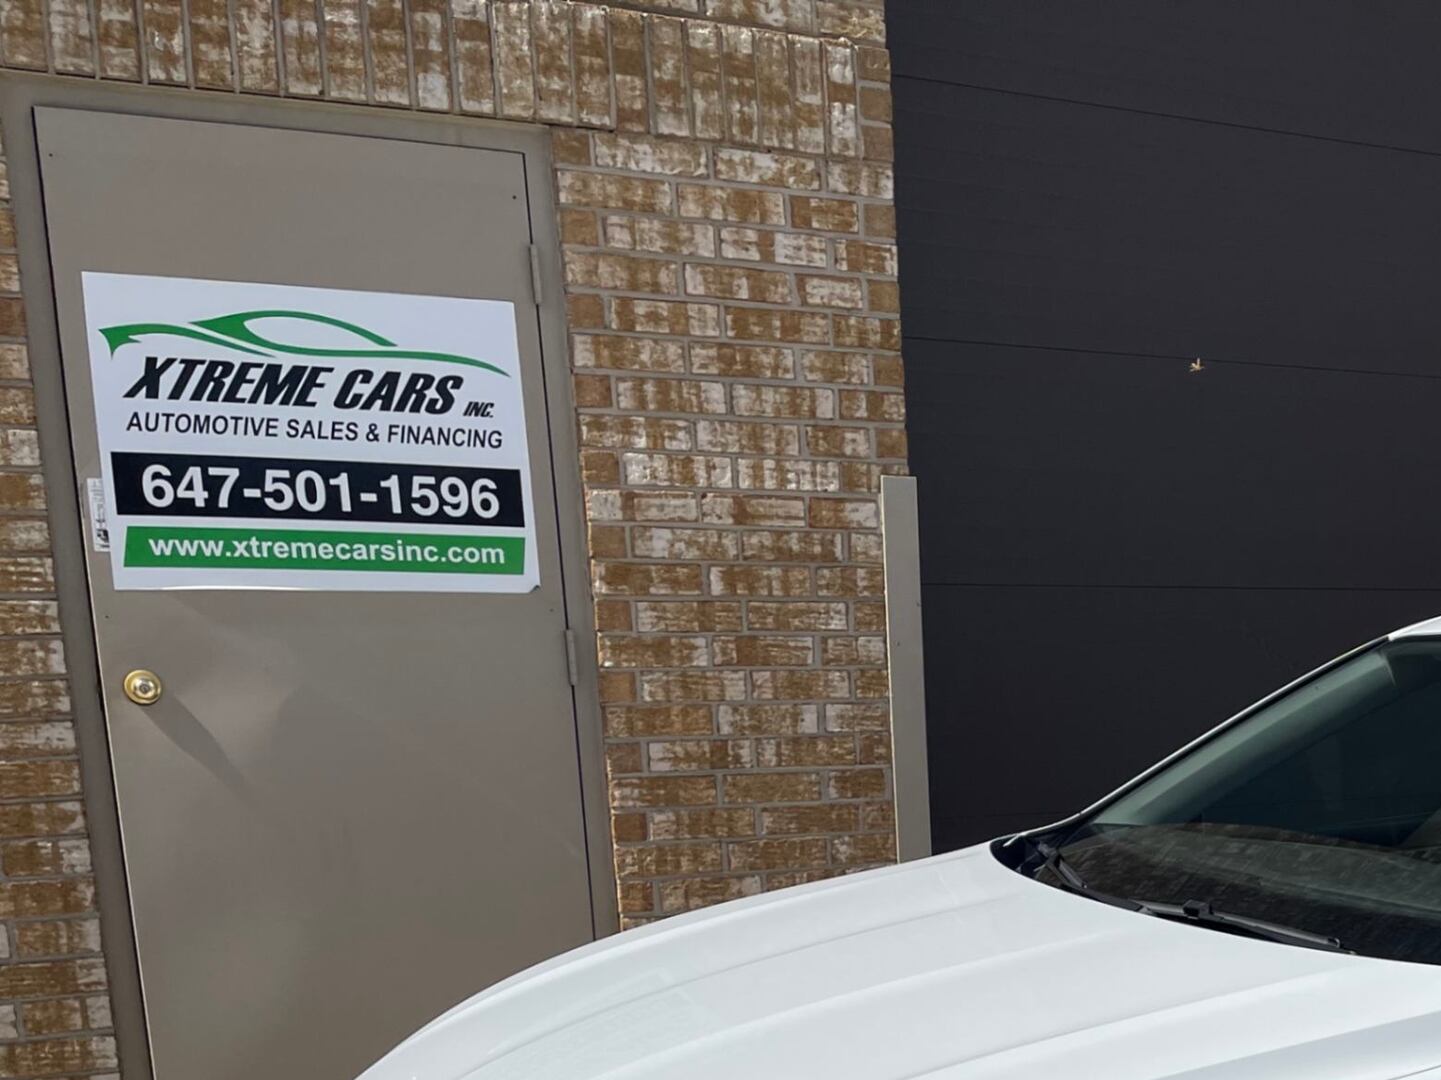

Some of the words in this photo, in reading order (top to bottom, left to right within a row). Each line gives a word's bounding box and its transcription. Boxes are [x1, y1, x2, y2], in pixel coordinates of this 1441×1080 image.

[124, 356, 334, 407] XTREME
[333, 369, 464, 415] CARS
[463, 401, 495, 419] INC.
[126, 412, 279, 439] AUTOMOTIVE
[286, 418, 358, 442] SALES
[365, 424, 380, 443] &
[387, 424, 503, 449] FINANCING
[141, 464, 500, 519] 647-501-1596
[148, 537, 506, 565] www.xtremecarsinc.com
